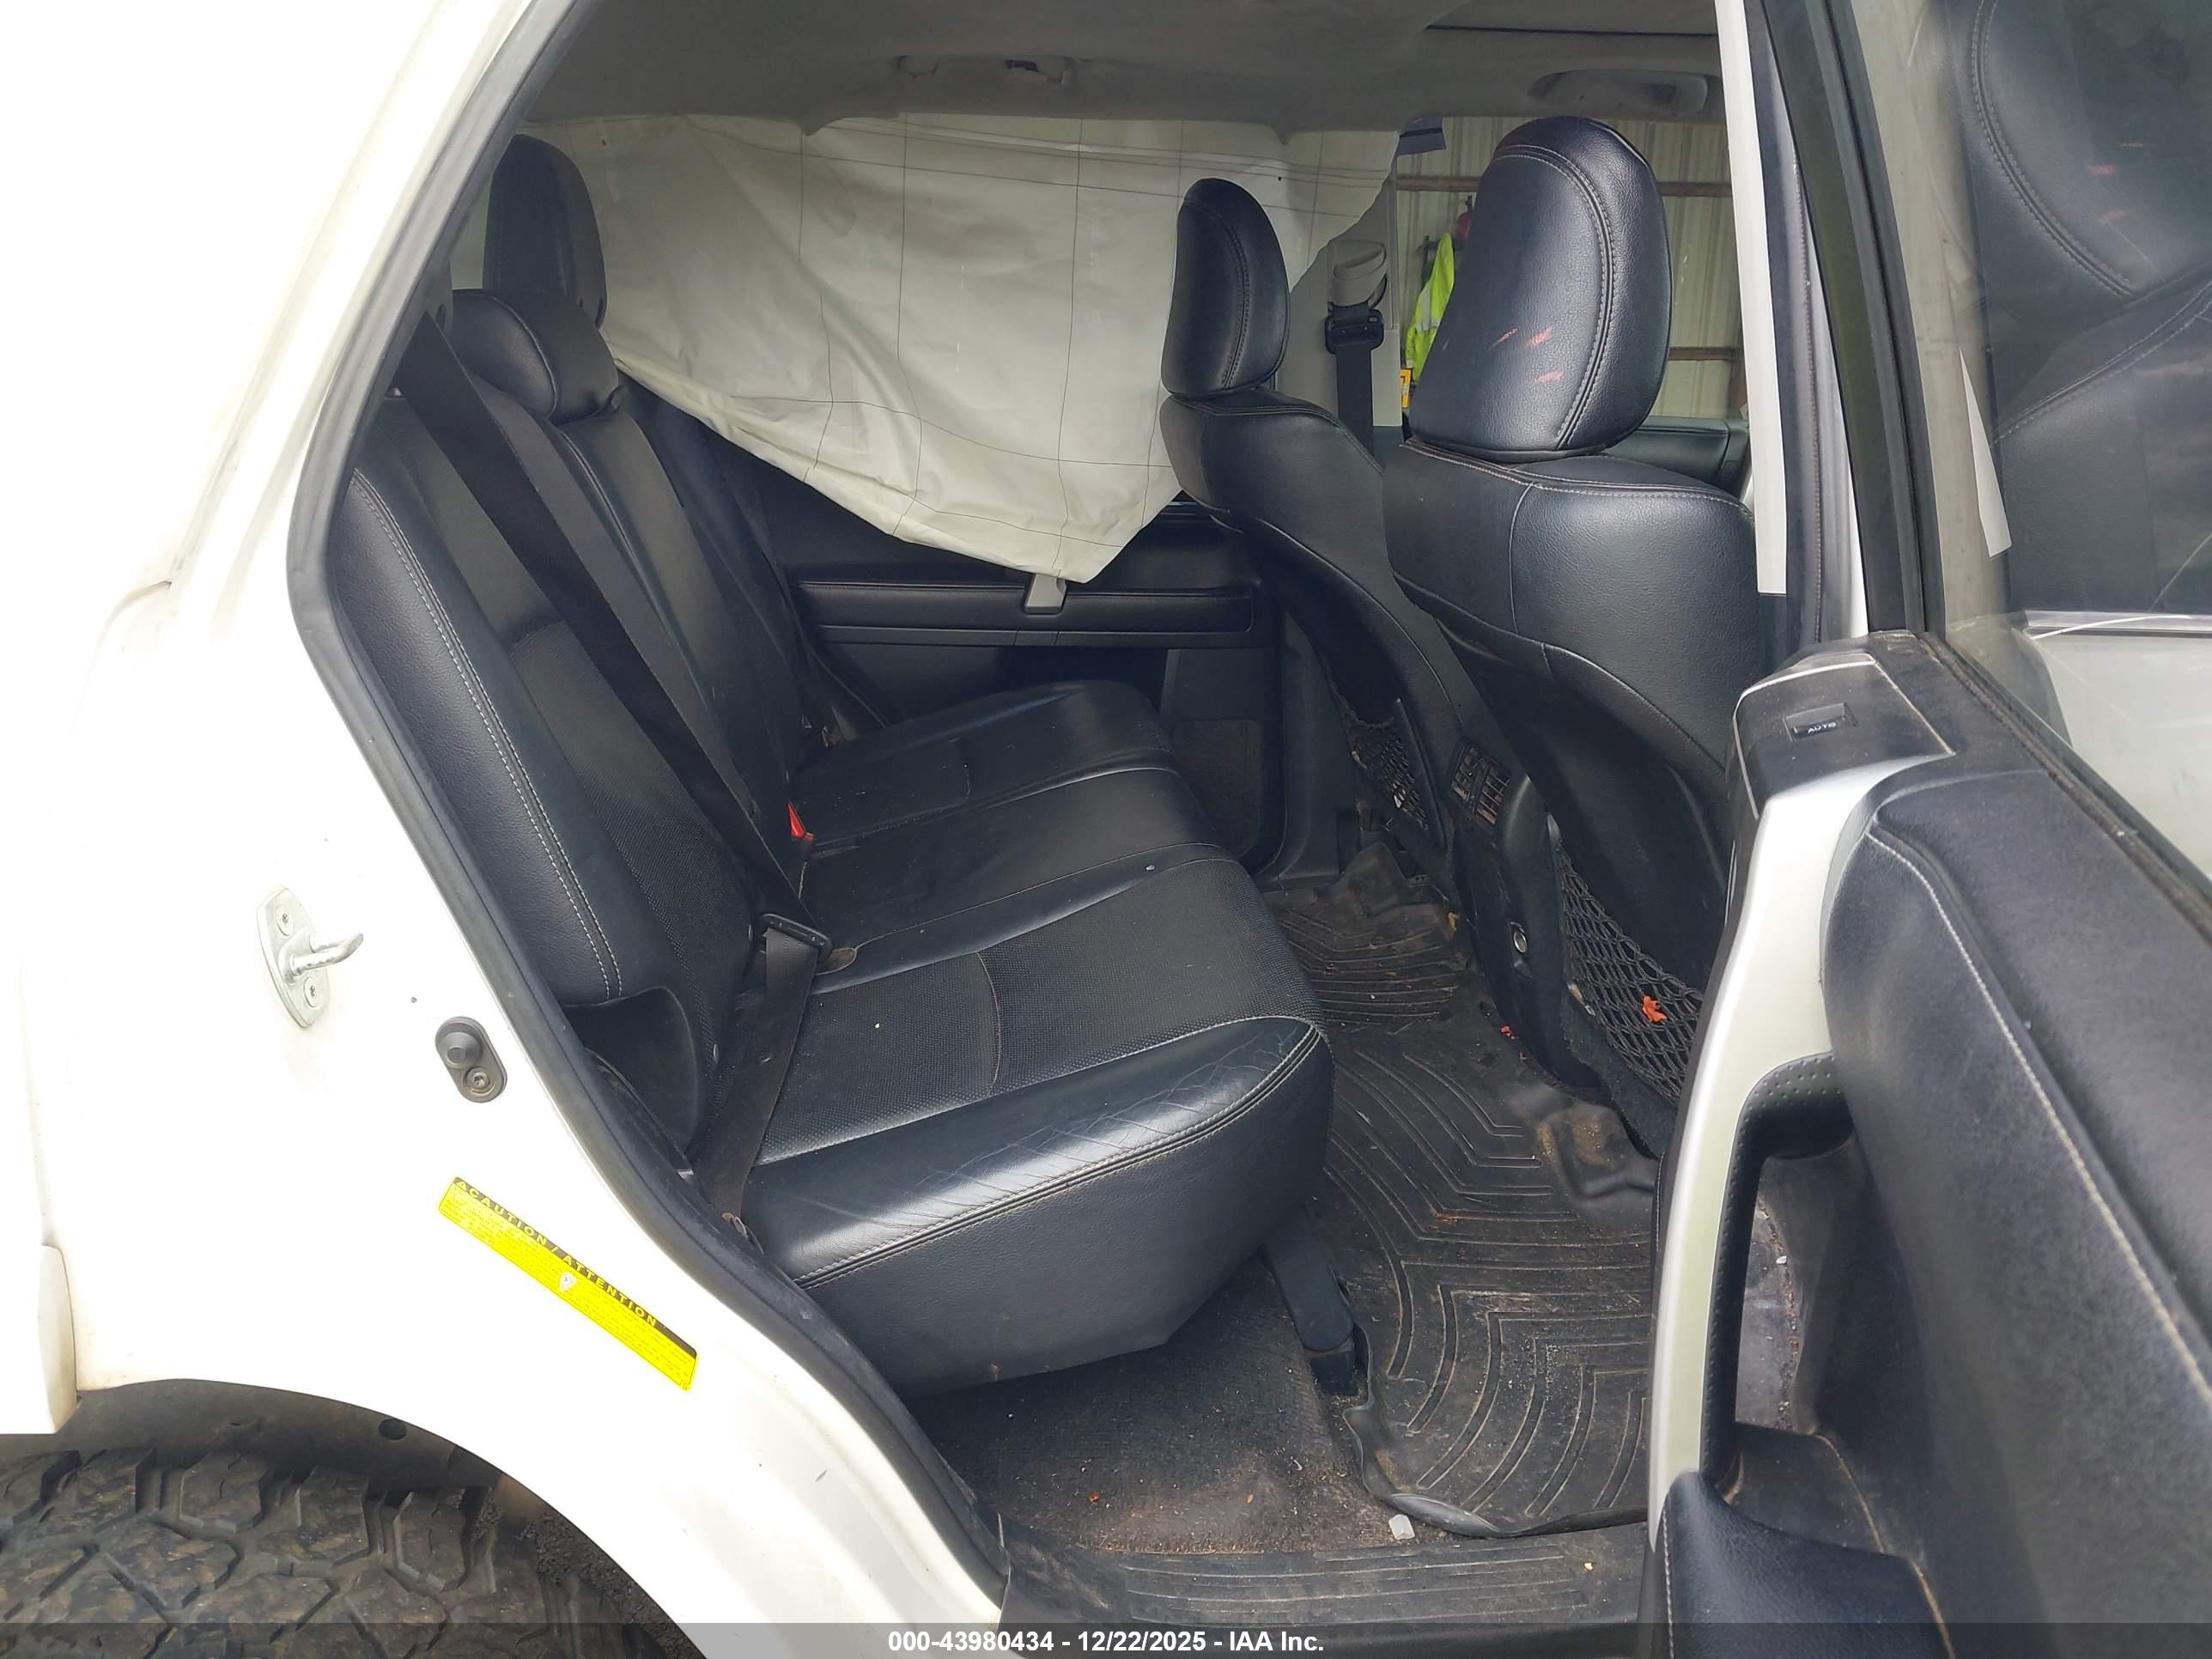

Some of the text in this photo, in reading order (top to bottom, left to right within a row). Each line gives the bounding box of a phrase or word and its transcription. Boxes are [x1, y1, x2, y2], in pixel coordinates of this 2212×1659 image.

[1807, 721, 1837, 734] AUTO
[468, 1187, 548, 1246] CAUTION
[562, 1255, 657, 1328] ATTENTION
